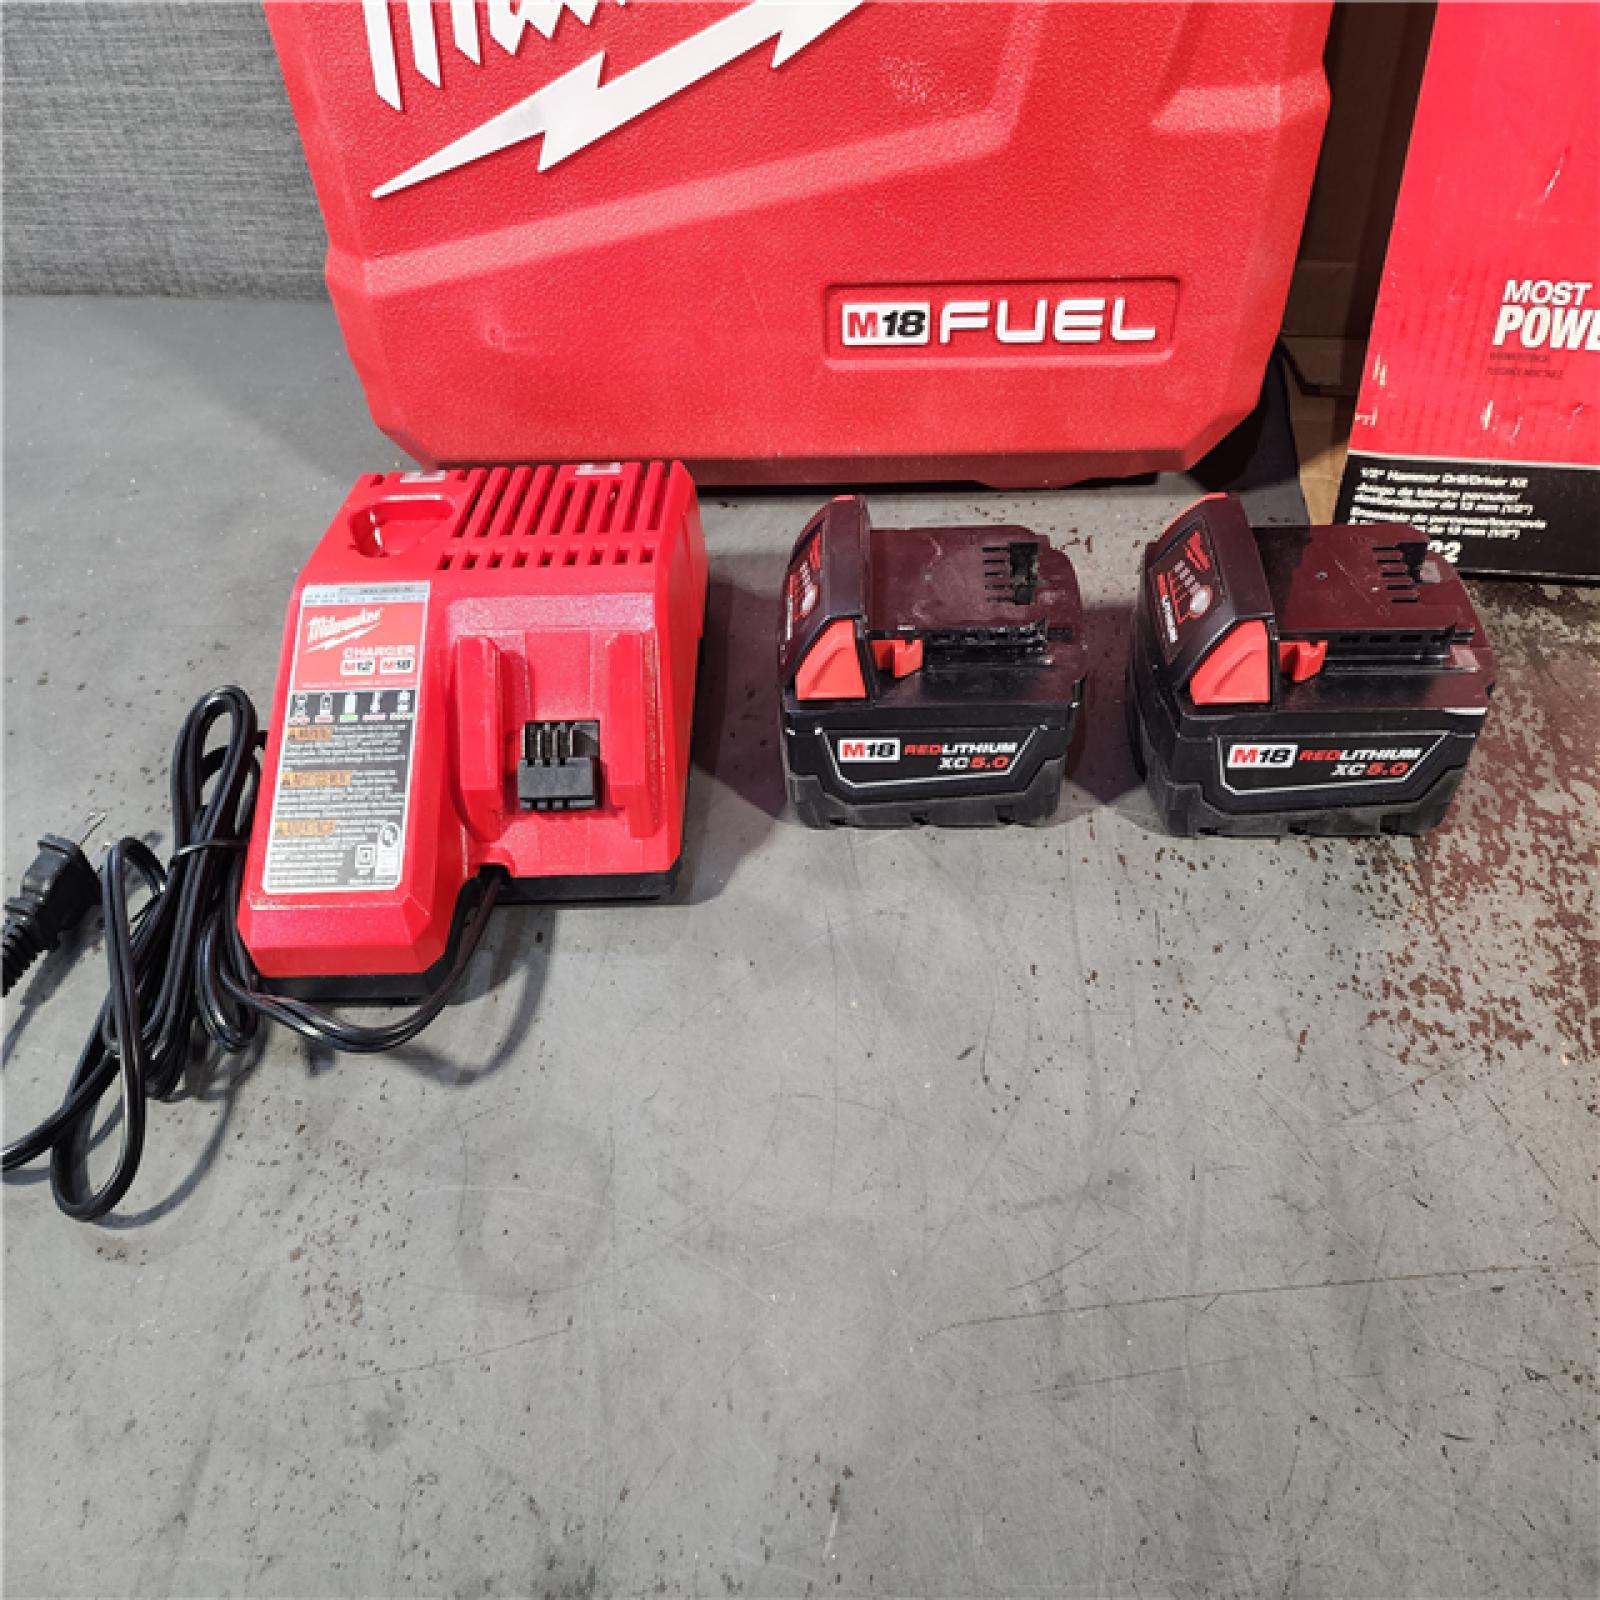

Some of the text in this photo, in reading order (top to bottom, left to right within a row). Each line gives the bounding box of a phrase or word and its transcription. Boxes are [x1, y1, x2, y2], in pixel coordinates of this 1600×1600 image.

[1503, 280, 1593, 305] MOST
[847, 297, 1156, 344] M18 FUEL
[841, 742, 1018, 758] M18 REDLITHIUM
[1232, 747, 1422, 763] M18 REDLITHIUM
